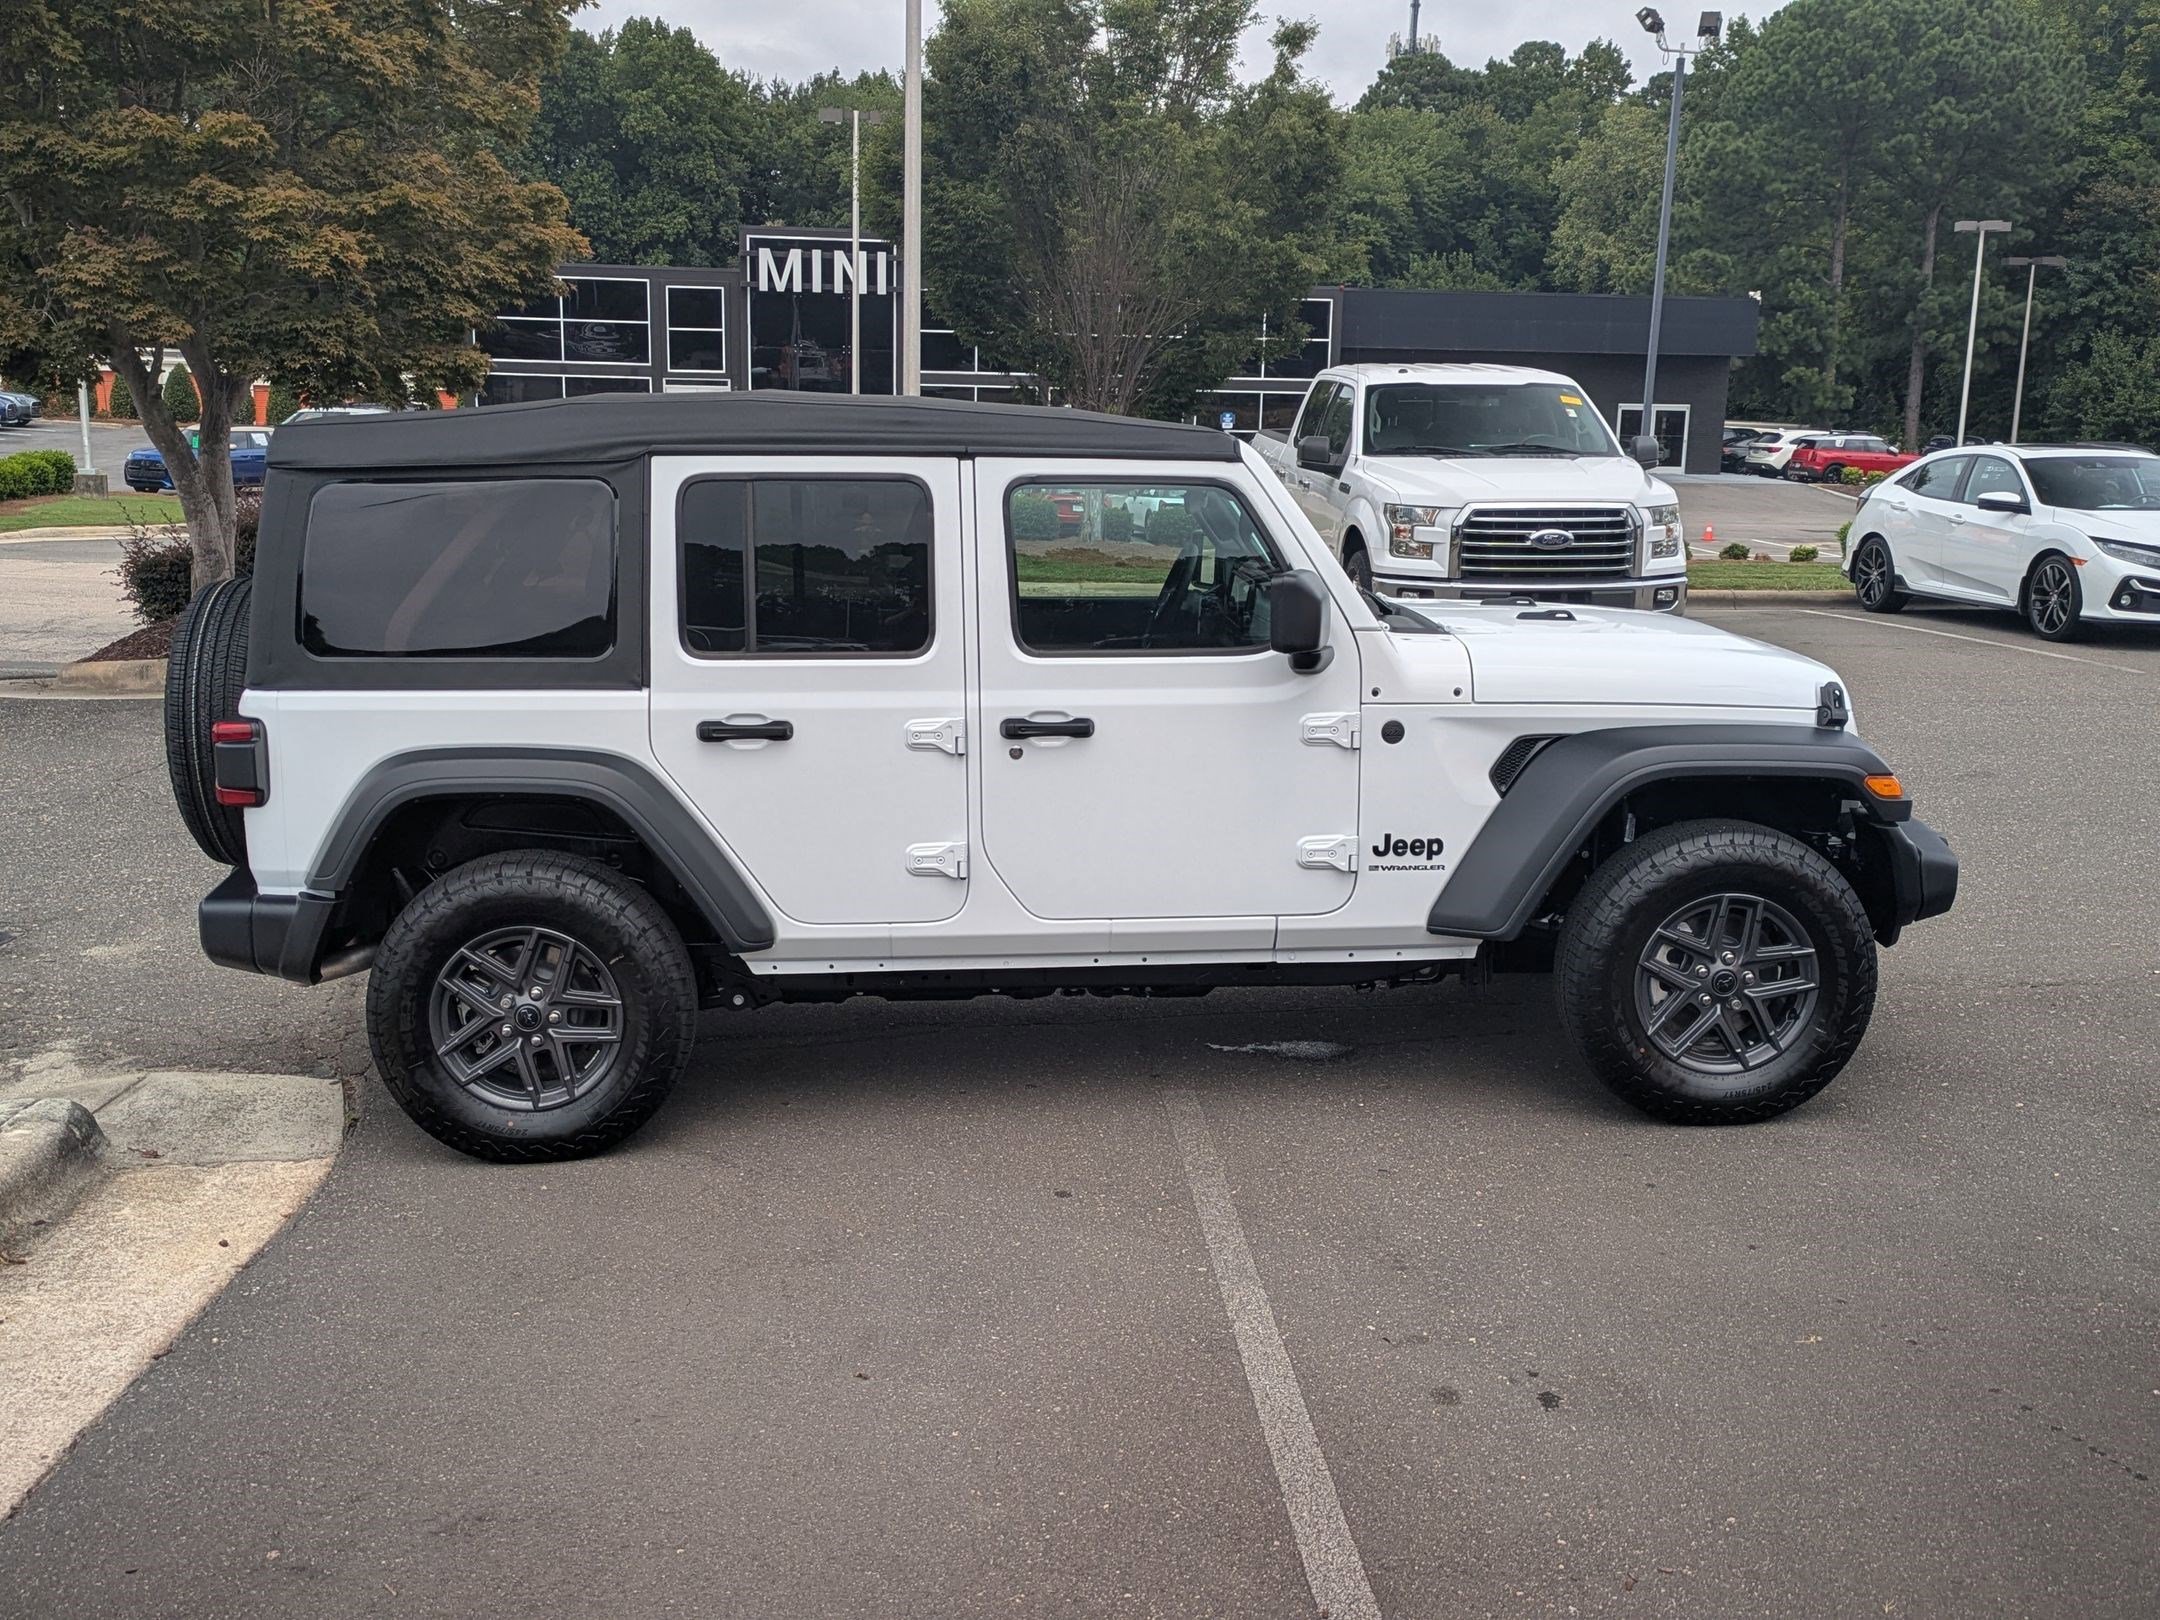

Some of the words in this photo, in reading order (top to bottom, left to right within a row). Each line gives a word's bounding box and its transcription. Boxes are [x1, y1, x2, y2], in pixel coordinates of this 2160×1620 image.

[758, 247, 887, 295] MINI
[1372, 833, 1444, 861] Jeep
[1380, 864, 1446, 872] WRANGLER
